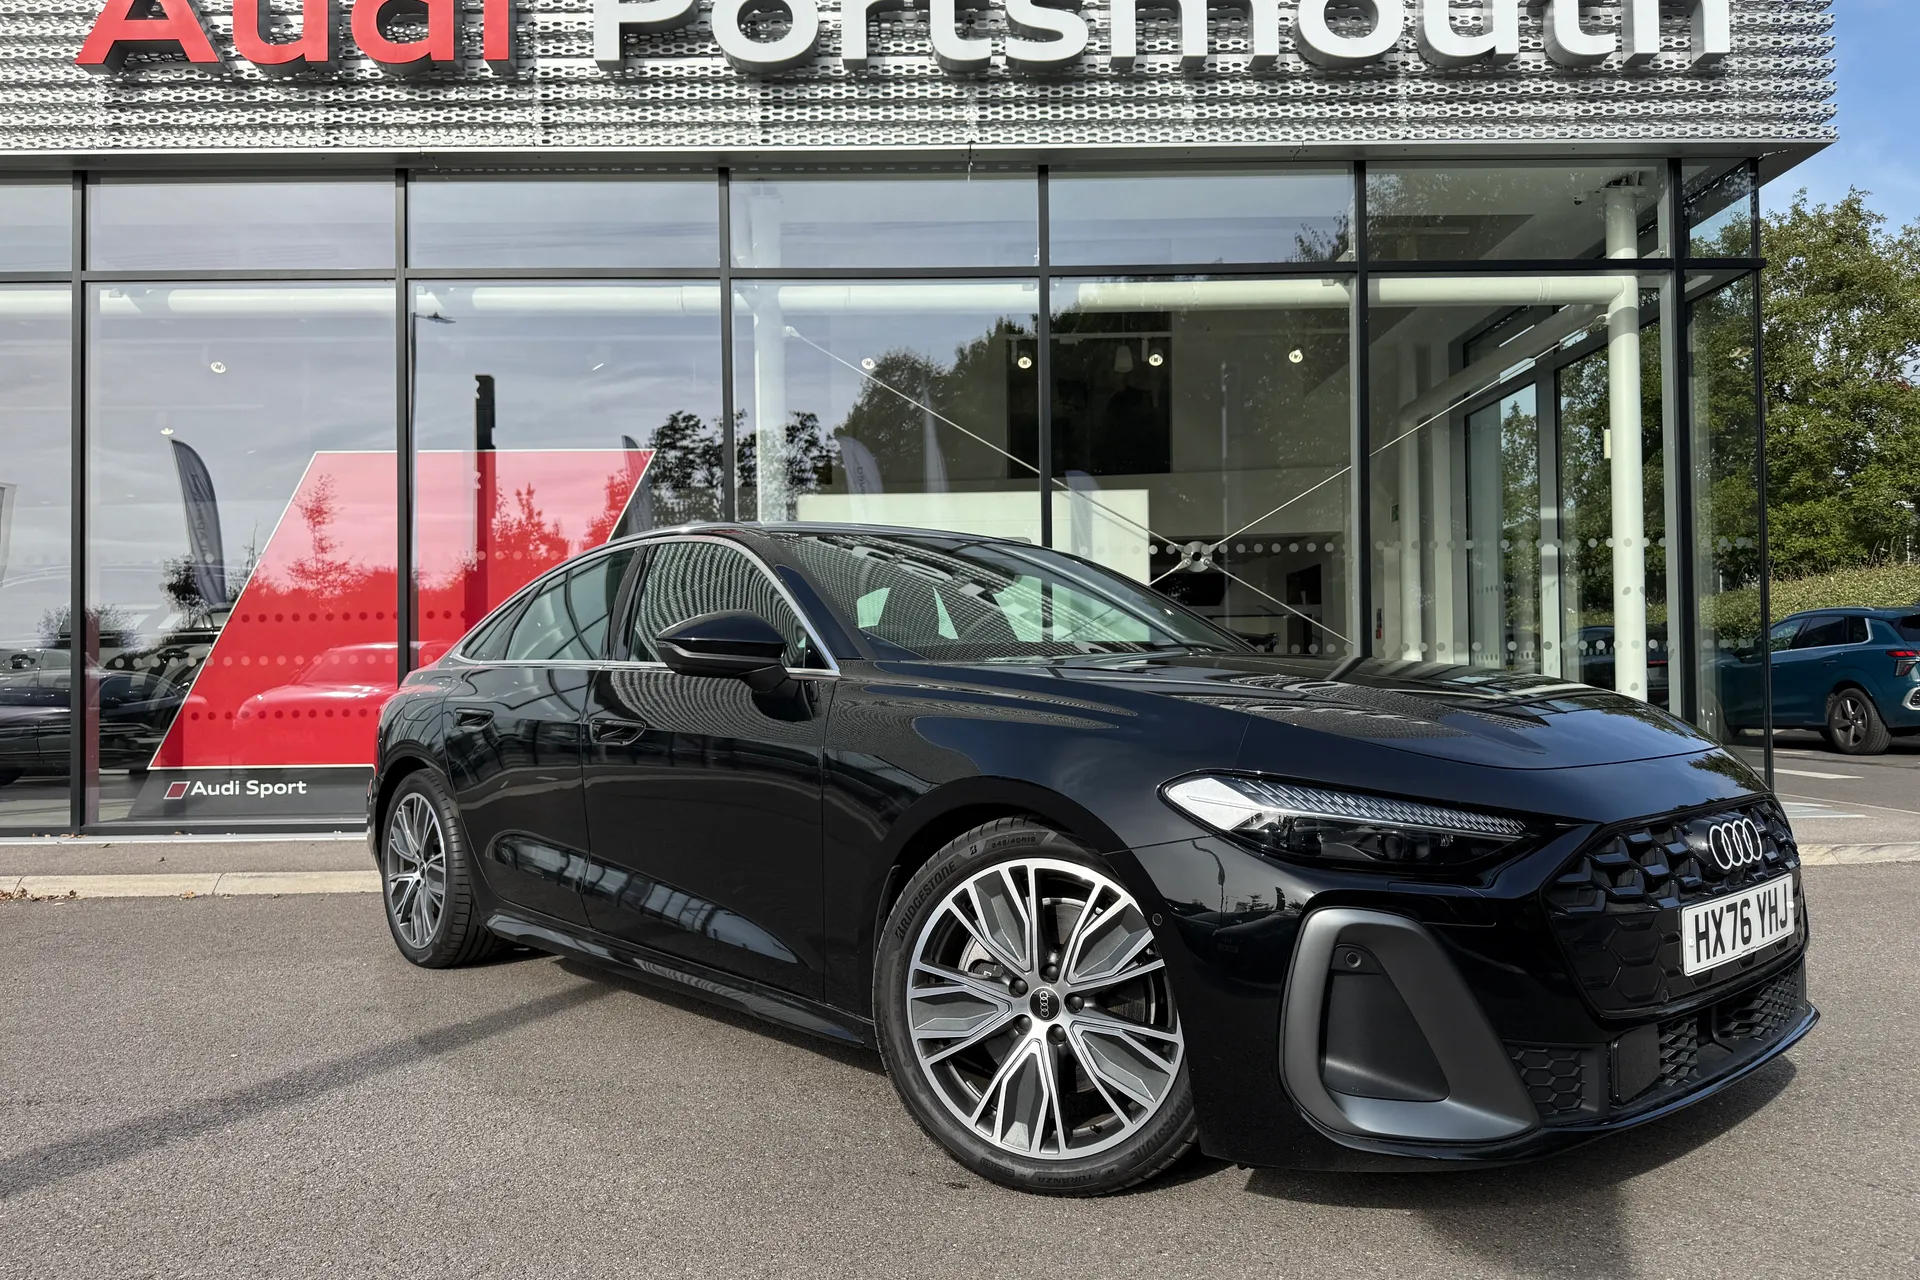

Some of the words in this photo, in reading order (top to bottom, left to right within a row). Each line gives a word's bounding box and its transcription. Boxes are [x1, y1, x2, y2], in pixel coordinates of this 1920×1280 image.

[75, 0, 509, 65] Audi
[190, 780, 240, 796] Audi
[245, 779, 308, 799] Sport
[894, 860, 958, 942] BRIDGESTONE
[1694, 897, 1753, 964] HX76
[1756, 883, 1788, 938] YHJ
[1037, 1173, 1094, 1184] TURANZA
